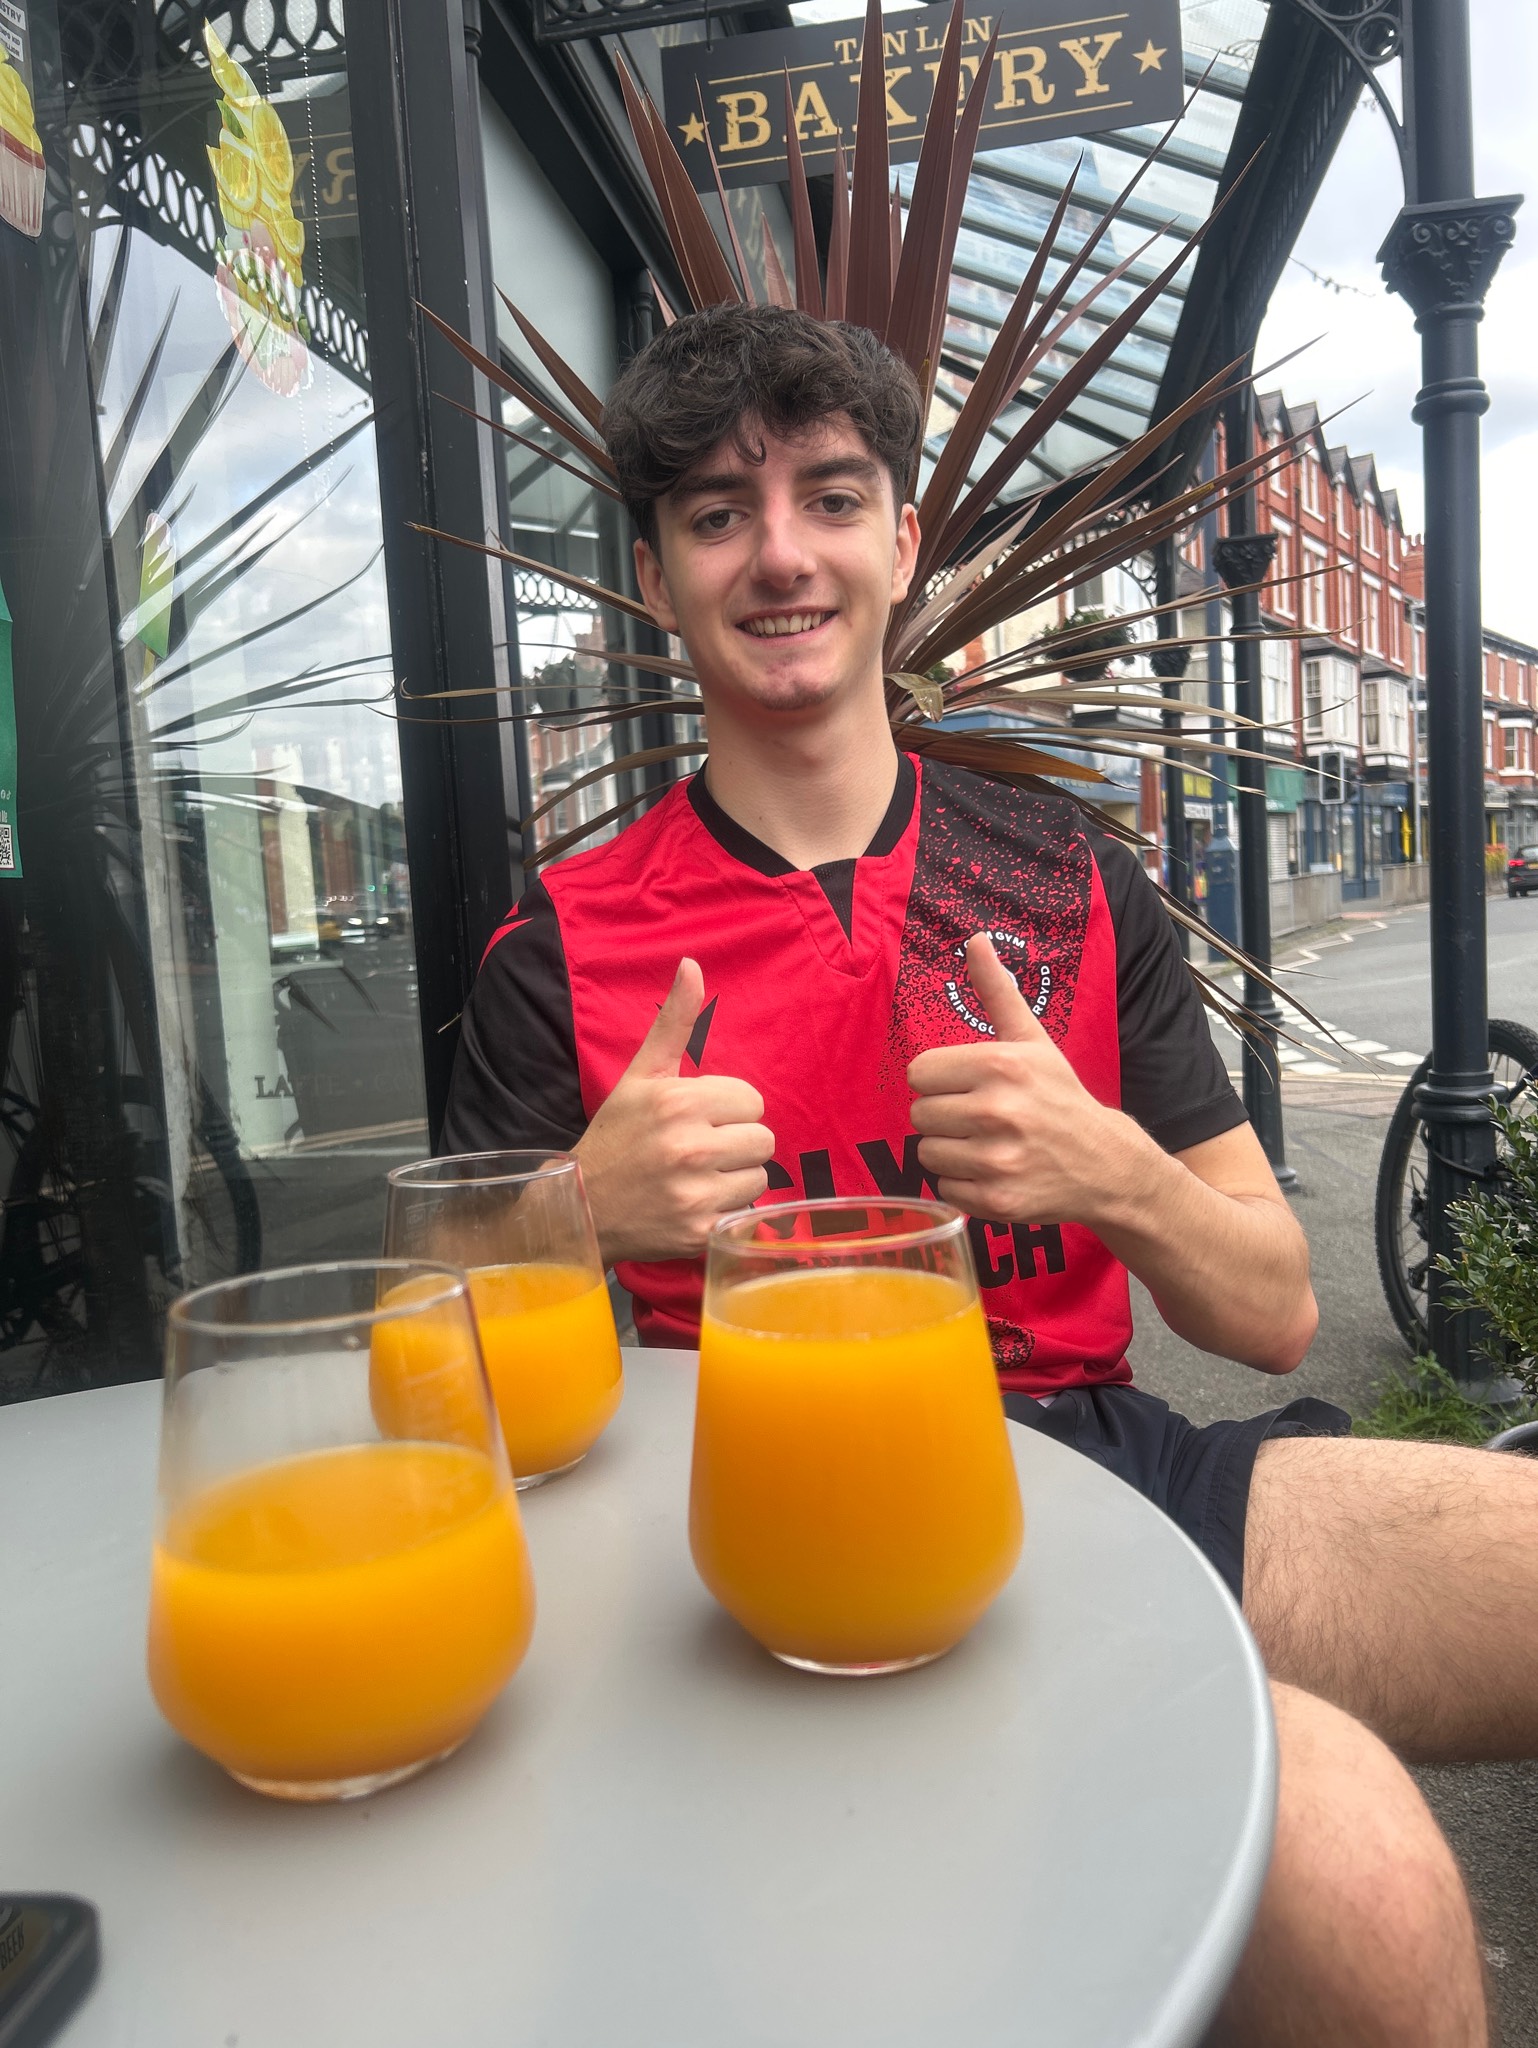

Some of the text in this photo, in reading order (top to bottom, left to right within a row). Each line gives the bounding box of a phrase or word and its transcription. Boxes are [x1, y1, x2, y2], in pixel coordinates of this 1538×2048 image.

[0, 2, 21, 23] STRY
[834, 29, 909, 65] TN
[716, 31, 1123, 152] BAKERY
[995, 931, 1026, 949] GYM
[946, 965, 1051, 1035] PRIFYSG RDYDD
[966, 1216, 1067, 1290] CH
